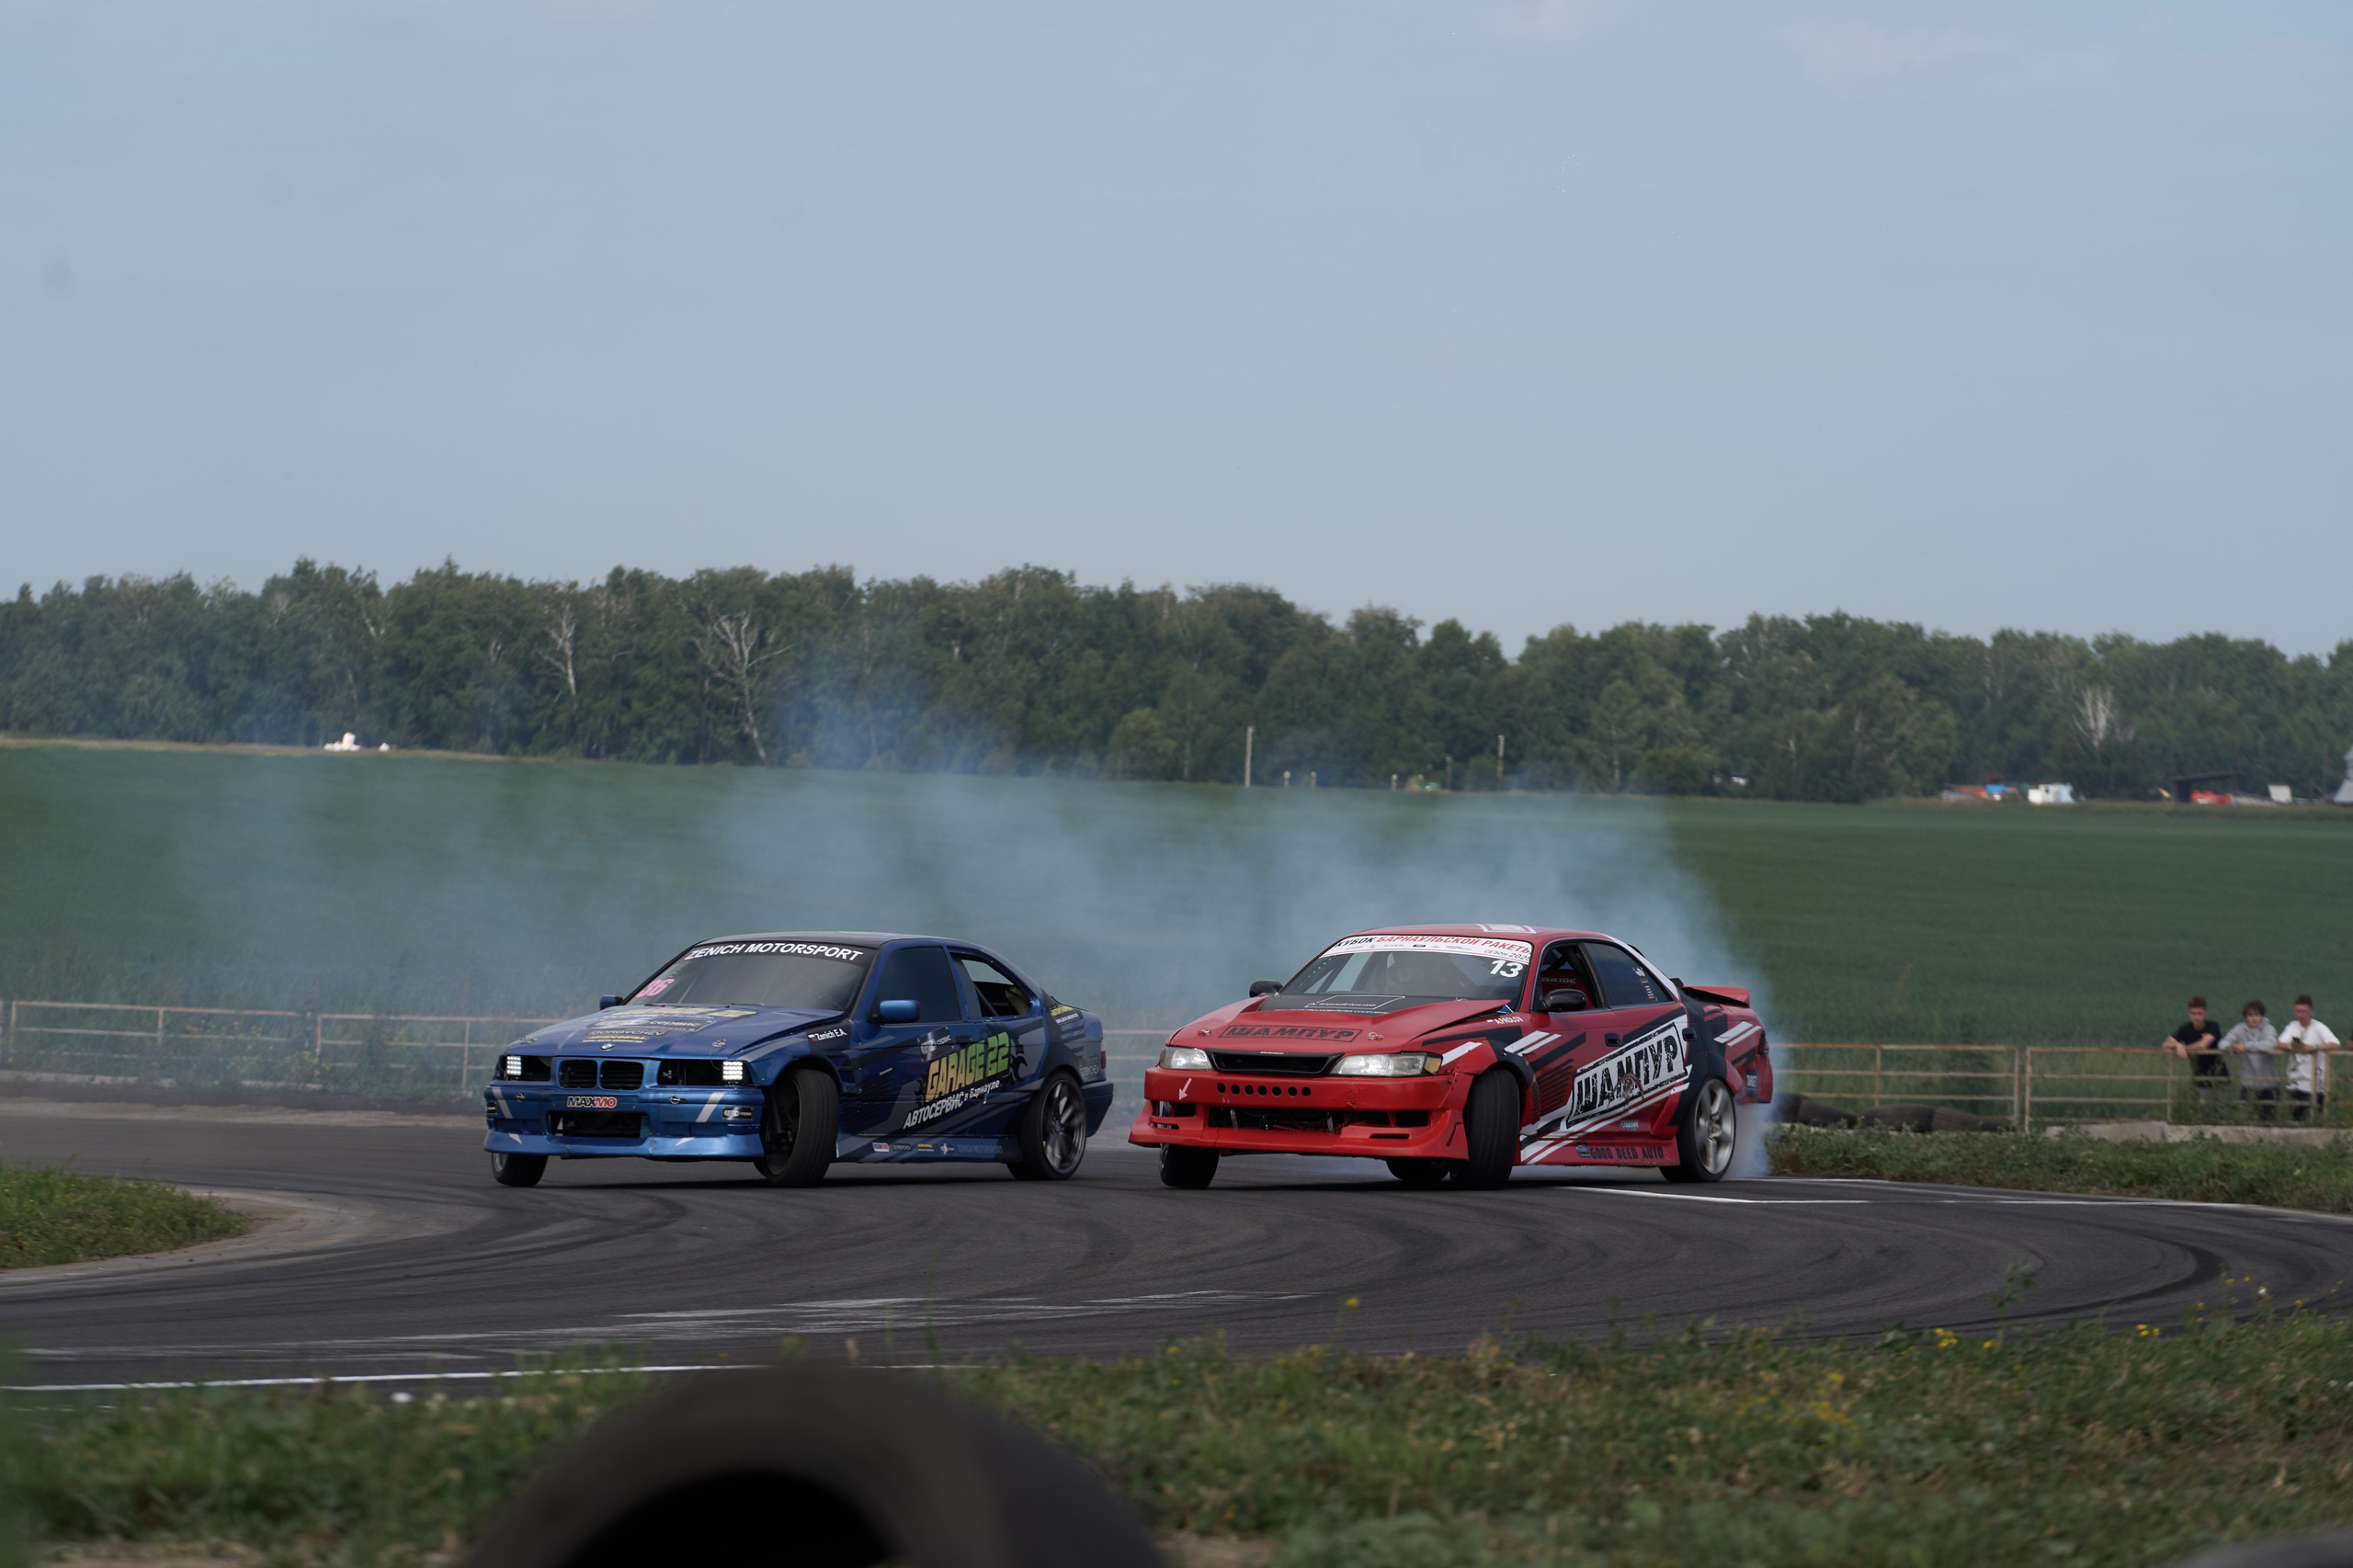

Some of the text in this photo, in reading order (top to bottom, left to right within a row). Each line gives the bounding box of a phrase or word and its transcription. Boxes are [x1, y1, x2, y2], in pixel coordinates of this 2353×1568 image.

[1335, 937, 1377, 948] КУБОК
[1377, 936, 1480, 945] БАРНАУЛЬСКОЙ
[684, 943, 863, 961] ZENICH MOTORSPORT
[1483, 949, 1508, 957] СЕЗОН
[1490, 960, 1524, 978] 13
[635, 978, 676, 998] 36
[814, 1030, 836, 1040] Zenich
[1228, 1027, 1355, 1040] ШАМПУР
[925, 1031, 1010, 1103] GARAGE 22
[1573, 1034, 1678, 1118] ШАМПУР
[903, 1091, 965, 1131] АВТОСЕРВИС
[969, 1079, 1001, 1098] Барнауле
[1589, 1145, 1664, 1160] GOOD DEED AUTO
